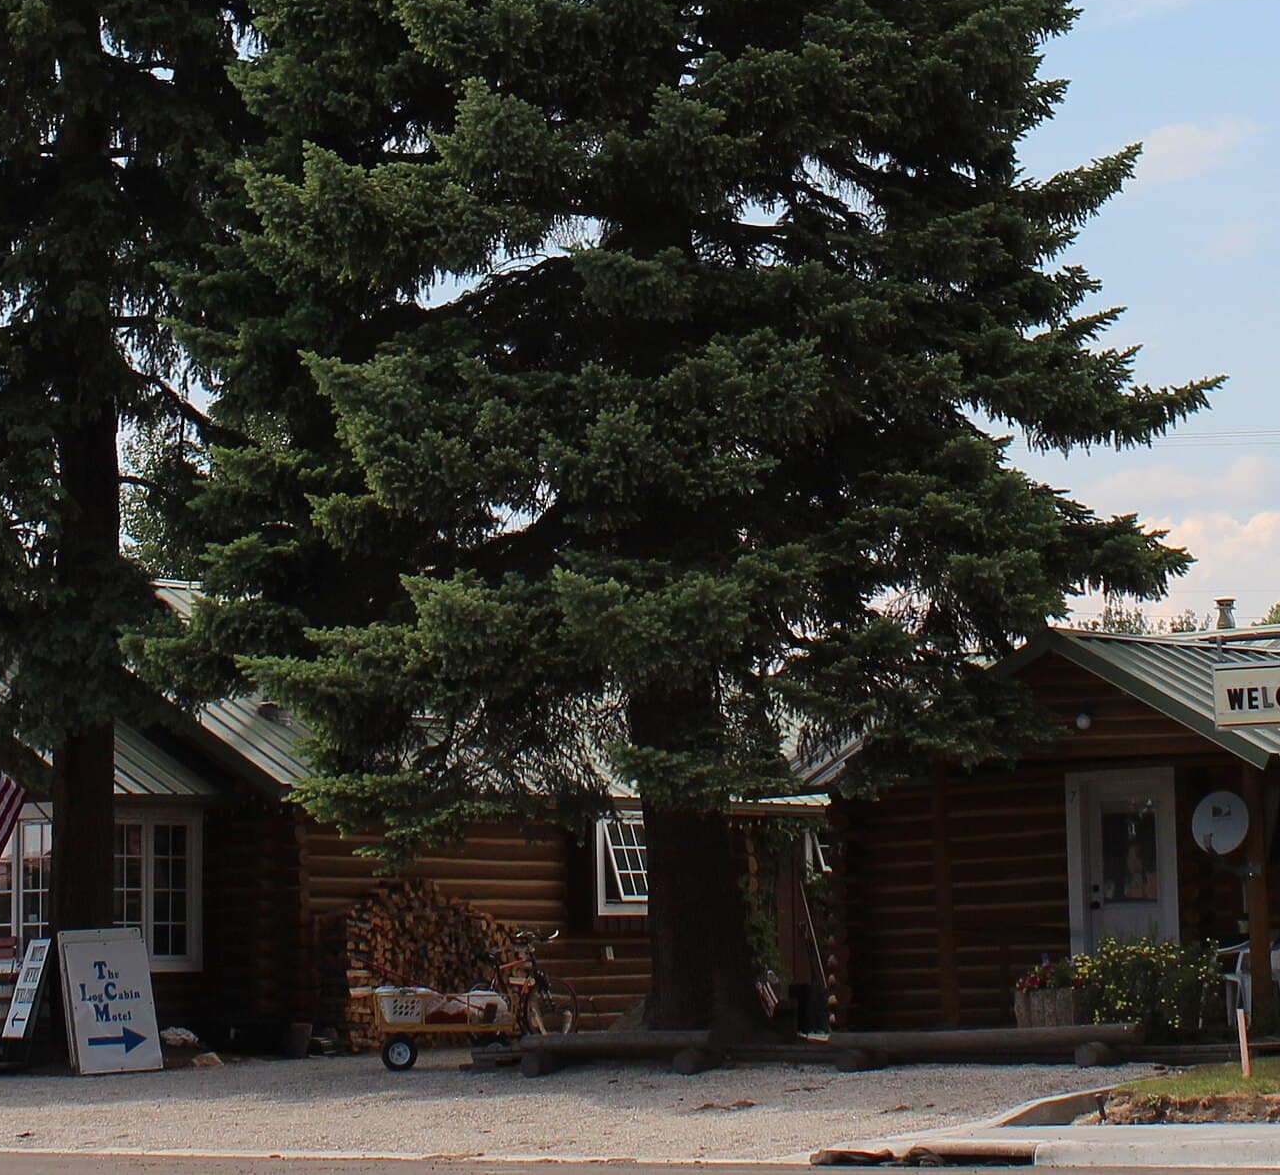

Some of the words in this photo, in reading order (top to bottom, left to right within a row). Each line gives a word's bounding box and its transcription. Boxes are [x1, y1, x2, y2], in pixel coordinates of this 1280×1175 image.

[93, 961, 120, 980] The
[79, 983, 103, 1002] Log
[104, 982, 141, 1001] Cabin
[93, 1003, 132, 1022] Motel
